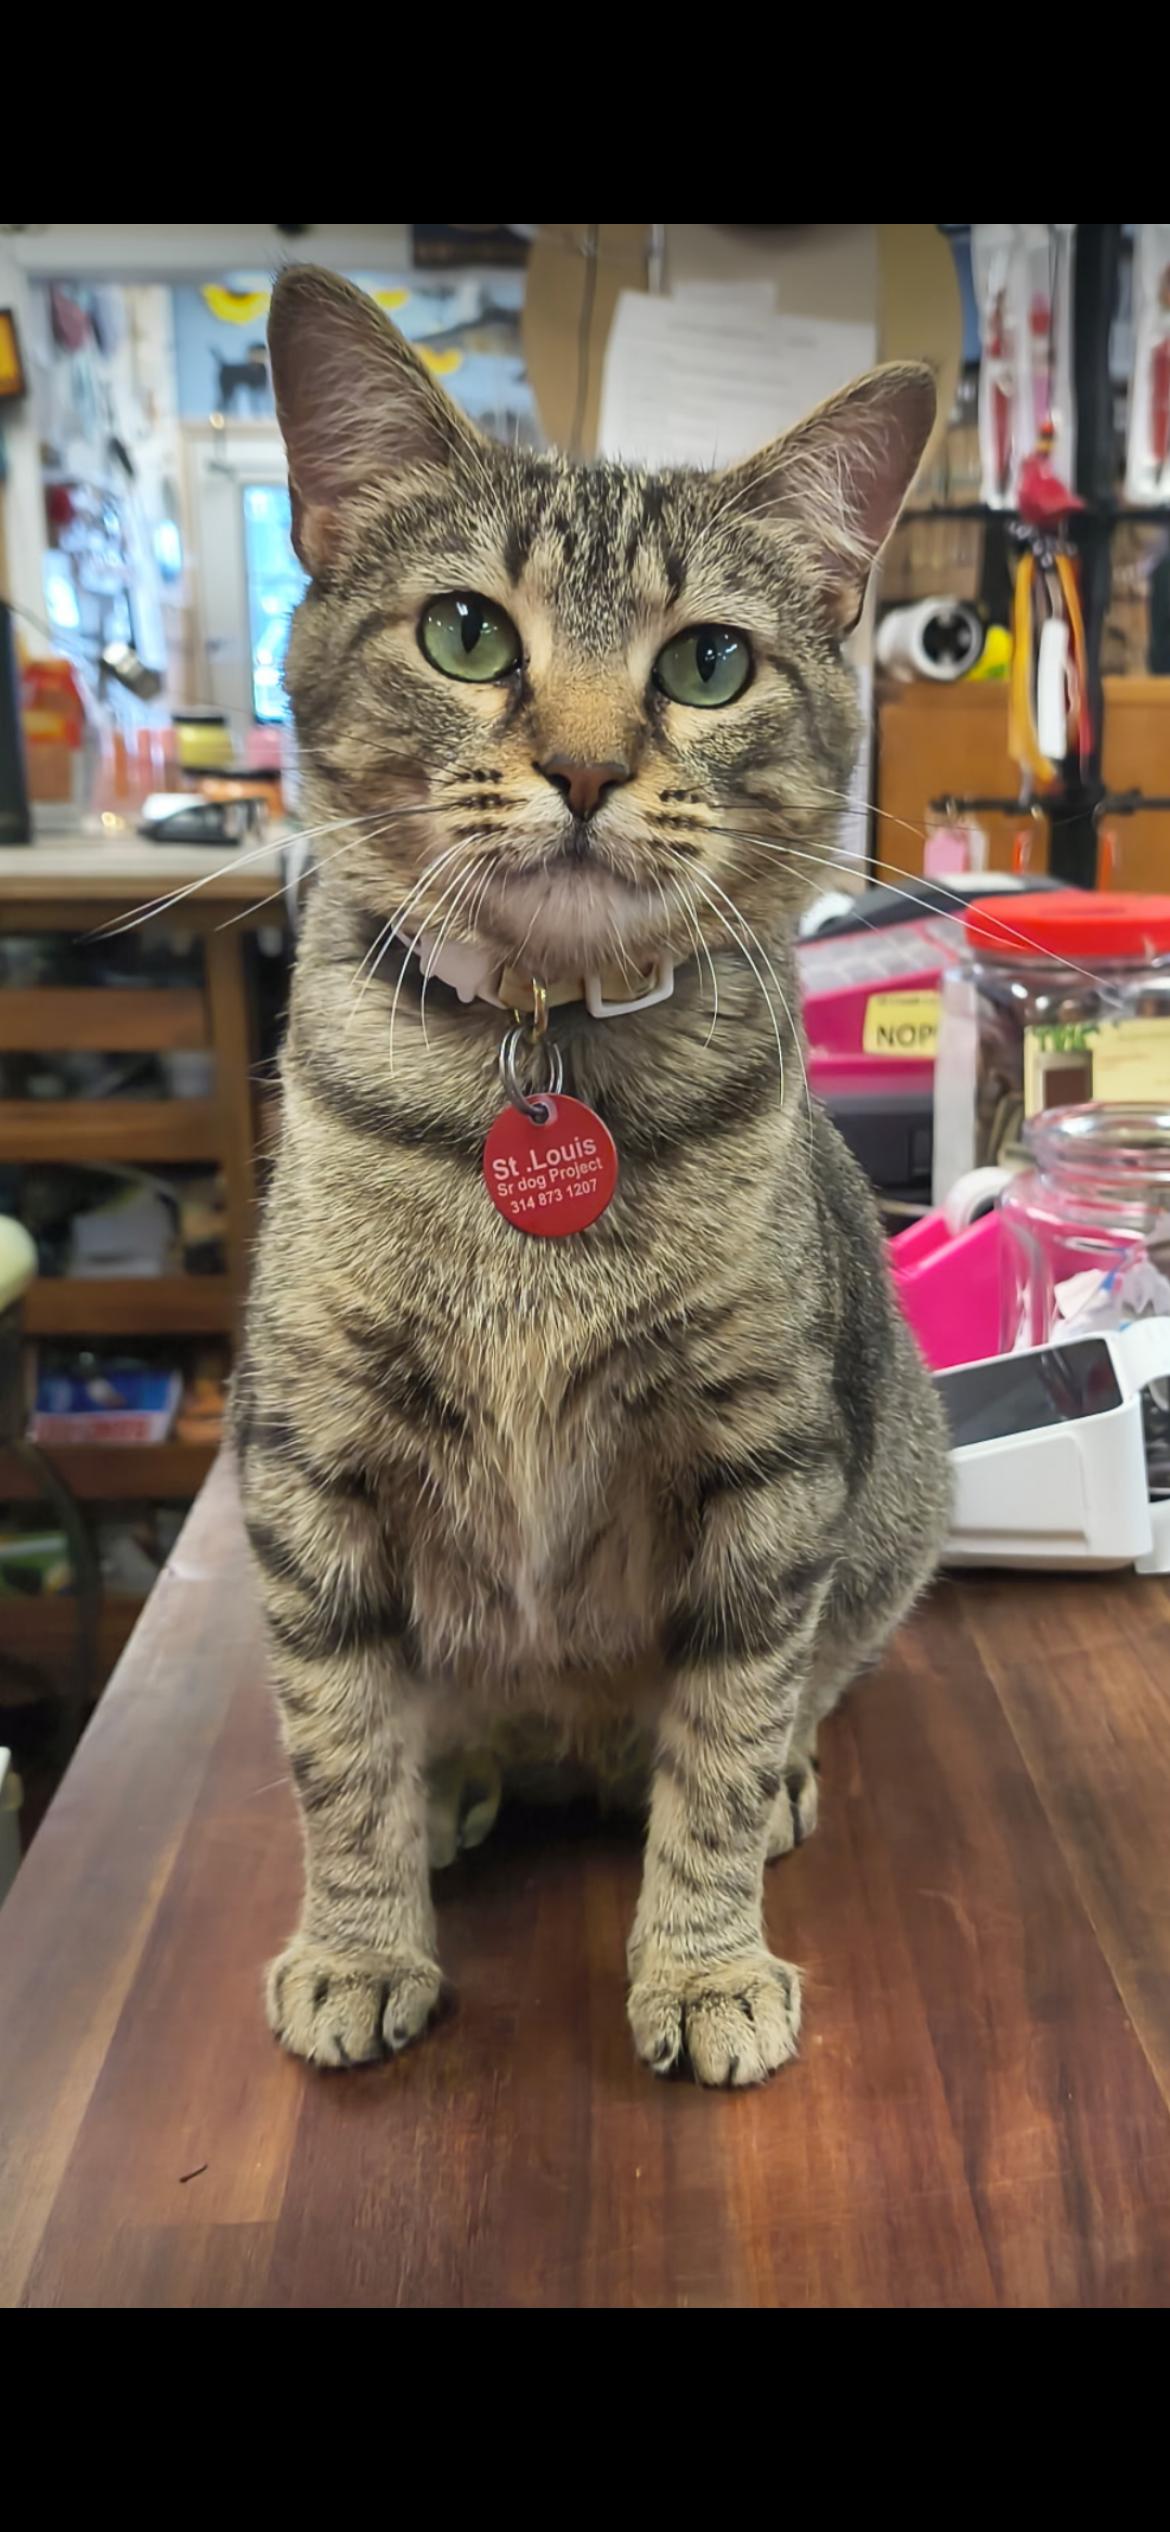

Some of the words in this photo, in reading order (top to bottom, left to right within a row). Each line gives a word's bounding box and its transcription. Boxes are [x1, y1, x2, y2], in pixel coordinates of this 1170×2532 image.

[877, 1024, 937, 1047] NOP
[492, 1156, 519, 1180] St
[497, 1183, 515, 1197] Sr
[518, 1174, 546, 1191] dog
[549, 1157, 603, 1183] Project
[510, 1196, 535, 1214] 314
[538, 1188, 563, 1206] 873
[566, 1178, 598, 1197] 1207
